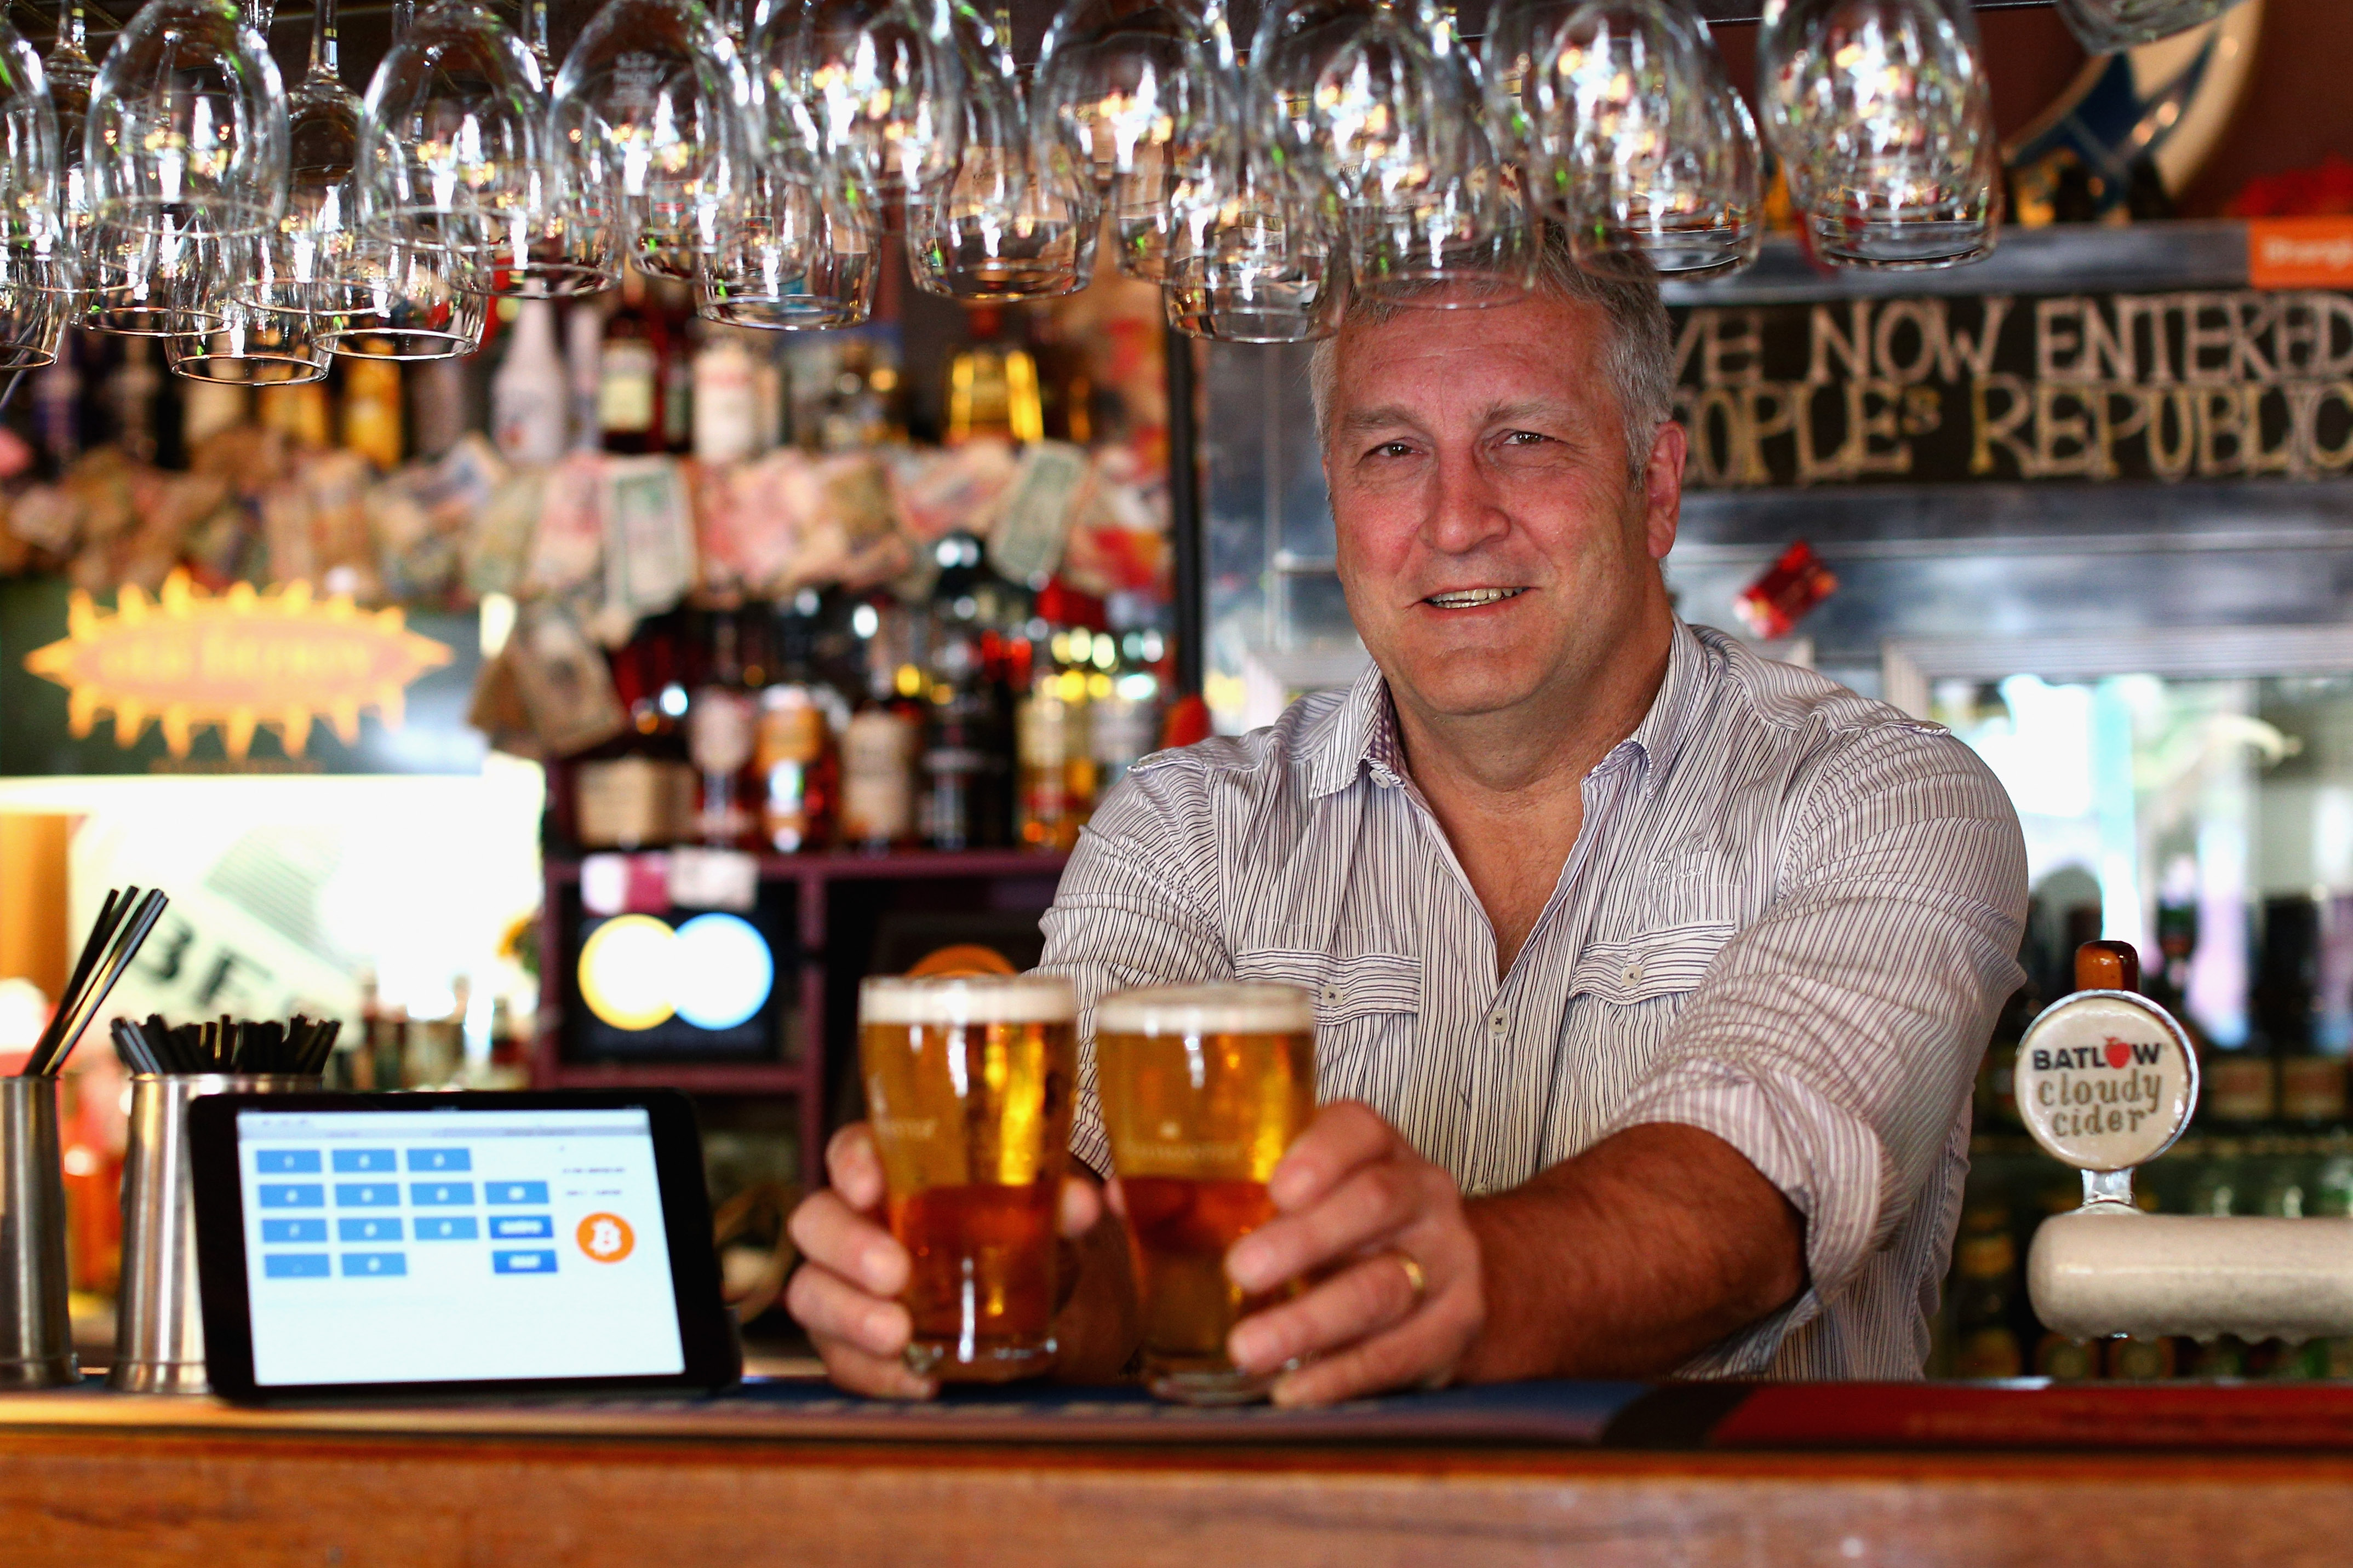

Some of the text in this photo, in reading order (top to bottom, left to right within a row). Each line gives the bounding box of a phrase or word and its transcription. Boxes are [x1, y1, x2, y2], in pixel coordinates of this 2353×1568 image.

[1808, 297, 2013, 384] NOW
[2035, 290, 2353, 384] ENTERED
[1970, 372, 2353, 483] REPUBLIC
[2033, 1037, 2161, 1070] BATLOW
[2037, 1068, 2162, 1113] cloudy
[2052, 1104, 2145, 1136] cider
